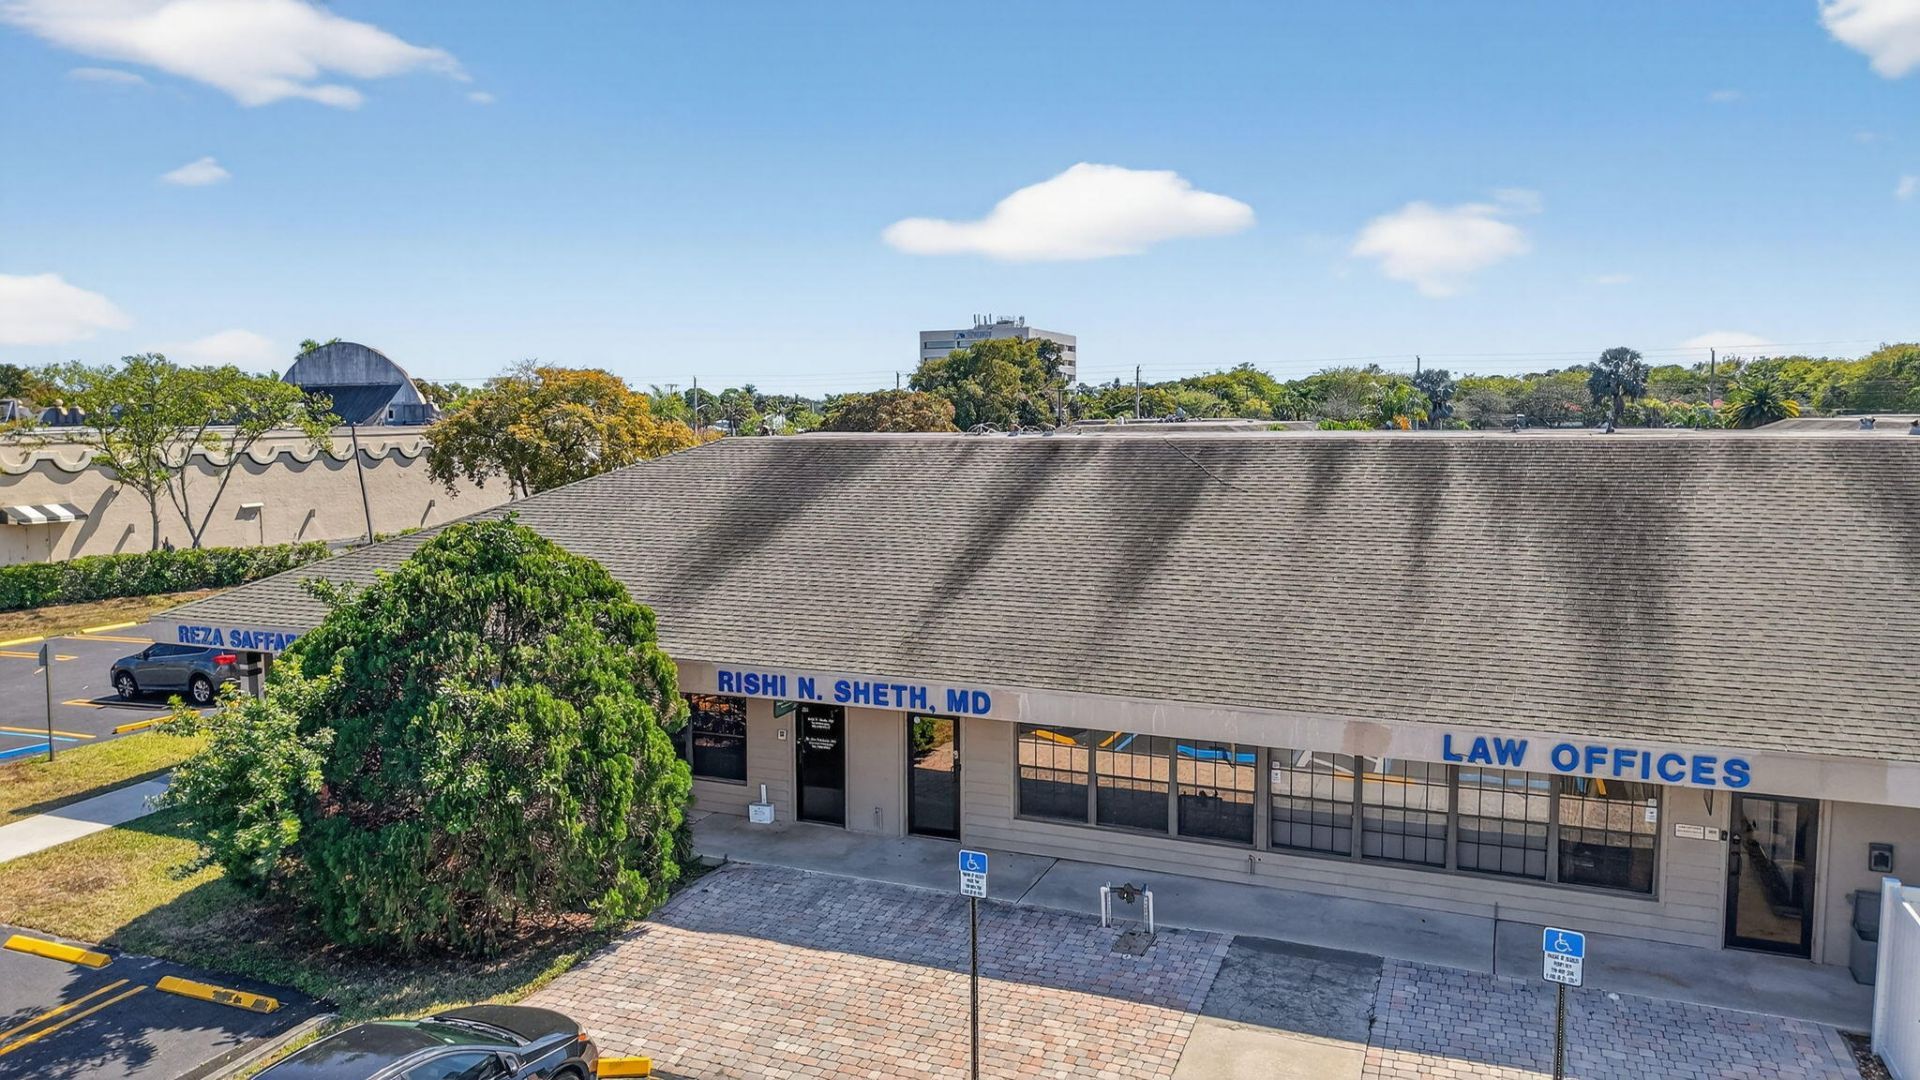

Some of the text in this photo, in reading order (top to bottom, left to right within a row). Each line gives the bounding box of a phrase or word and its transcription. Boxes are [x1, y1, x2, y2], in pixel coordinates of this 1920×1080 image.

[178, 625, 224, 646] REZA
[719, 671, 991, 716] RISHI N. SHETH, MD
[1443, 734, 1751, 788] LAW OFFICES
